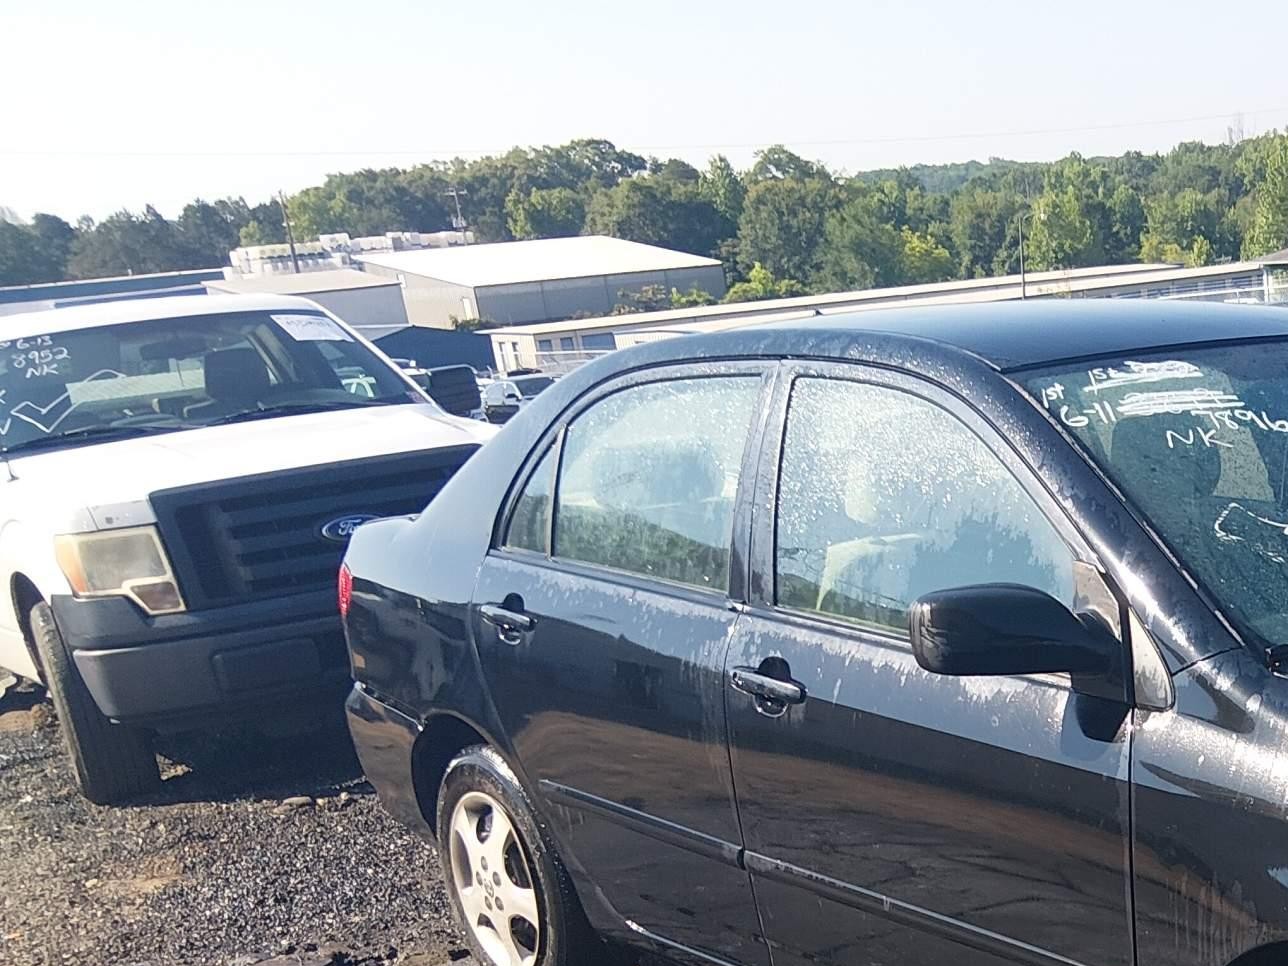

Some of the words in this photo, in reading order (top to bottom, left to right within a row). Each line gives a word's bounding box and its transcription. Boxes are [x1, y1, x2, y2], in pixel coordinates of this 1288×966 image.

[16, 335, 53, 350] 6-13
[11, 346, 71, 369] 8952
[25, 363, 59, 379] NK
[1060, 400, 1117, 428] 6-11
[1165, 426, 1234, 449] NK
